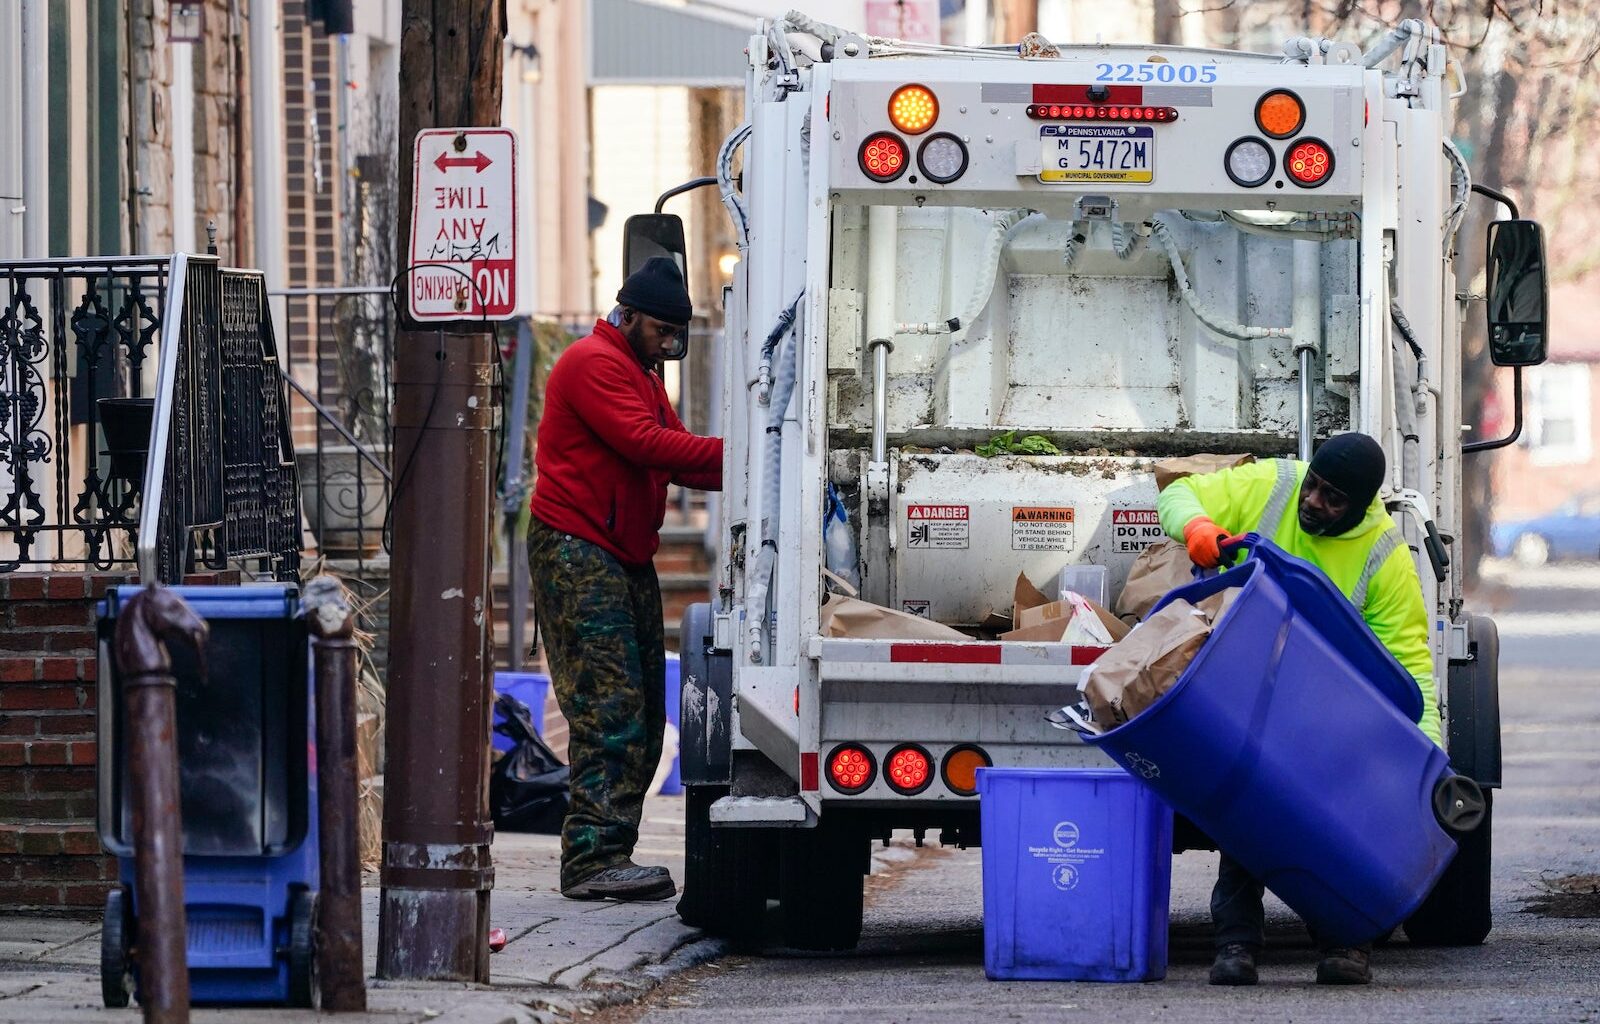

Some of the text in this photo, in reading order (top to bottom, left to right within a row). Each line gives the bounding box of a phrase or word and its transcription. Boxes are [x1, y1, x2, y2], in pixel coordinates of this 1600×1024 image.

[1095, 63, 1217, 83] 225005
[1067, 127, 1126, 137] PENNSYLVANIA
[1058, 139, 1069, 150] M
[1079, 140, 1146, 169] 5472M
[1058, 157, 1068, 168] G
[434, 187, 488, 209] TIME
[436, 218, 486, 241] ANY
[416, 268, 510, 306] NO PARKING
[923, 507, 967, 519] DANGER
[1027, 511, 1072, 521] WARNING
[1117, 527, 1137, 537] DO
[1121, 541, 1155, 551] ENT
